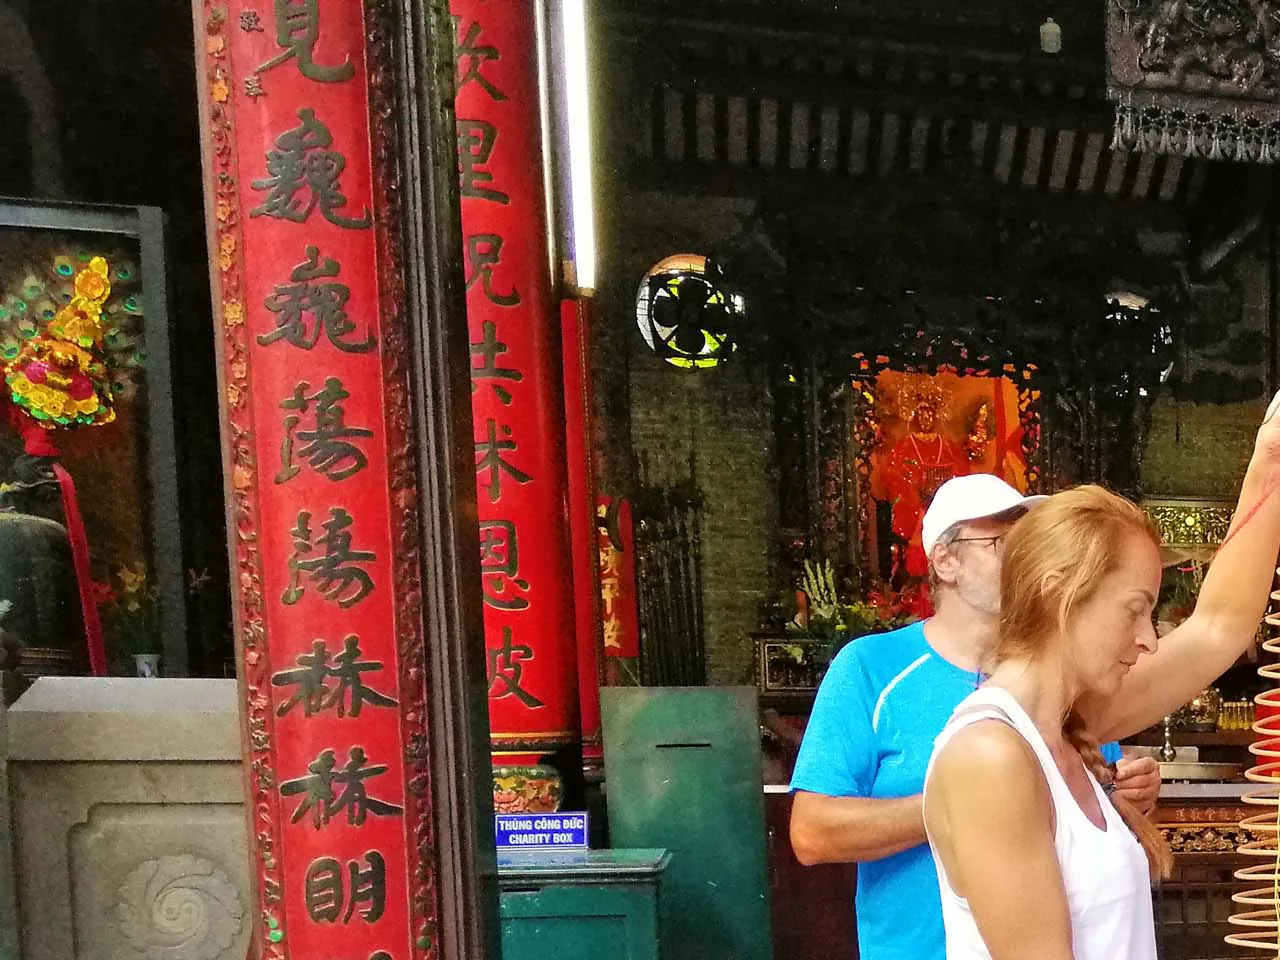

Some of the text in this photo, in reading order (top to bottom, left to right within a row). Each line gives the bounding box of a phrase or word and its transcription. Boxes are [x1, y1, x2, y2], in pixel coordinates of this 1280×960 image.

[498, 816, 584, 831] THÙNG CÔNG ĐỨC
[508, 833, 573, 844] CHARITY BOX
